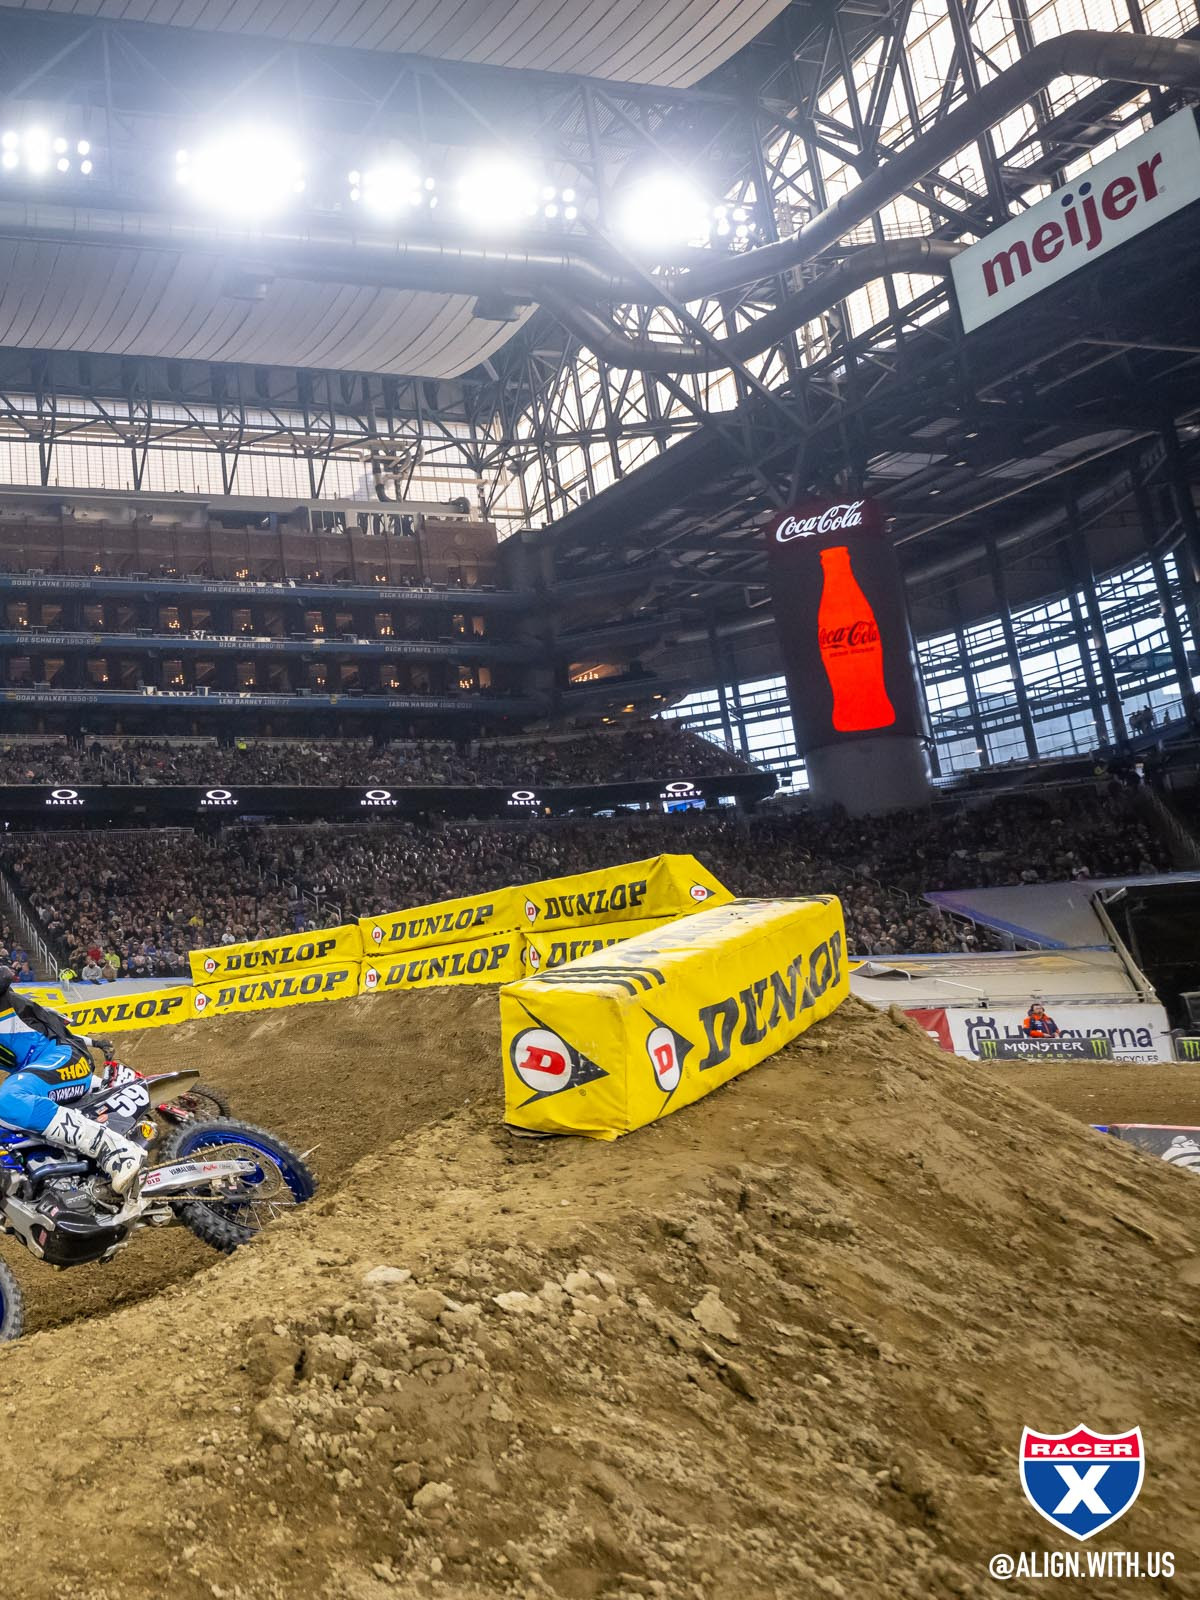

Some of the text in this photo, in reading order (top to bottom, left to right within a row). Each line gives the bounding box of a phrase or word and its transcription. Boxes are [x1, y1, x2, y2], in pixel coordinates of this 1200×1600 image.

[981, 152, 1164, 297] meijer
[776, 500, 865, 543] Coca-Cola
[10, 579, 36, 587] BOBBY
[37, 579, 60, 588] LAYNE
[30, 637, 66, 645] SCHMIDT
[15, 694, 37, 702] DOAK
[38, 694, 68, 702] WALKER
[235, 698, 263, 706] BARNEY
[410, 701, 440, 709] HANSON
[659, 790, 703, 799] OAKLEY
[543, 880, 648, 920] DUNLOP
[388, 904, 494, 942] DUNLOP
[224, 939, 336, 971] DUNLOP
[385, 942, 511, 986] DUNLOP
[215, 970, 350, 1008] DUNLOP
[698, 930, 842, 1072] DUNLOP
[66, 996, 184, 1028] UNLOP
[55, 1084, 86, 1101] YAMAHA
[105, 1083, 150, 1118] 59
